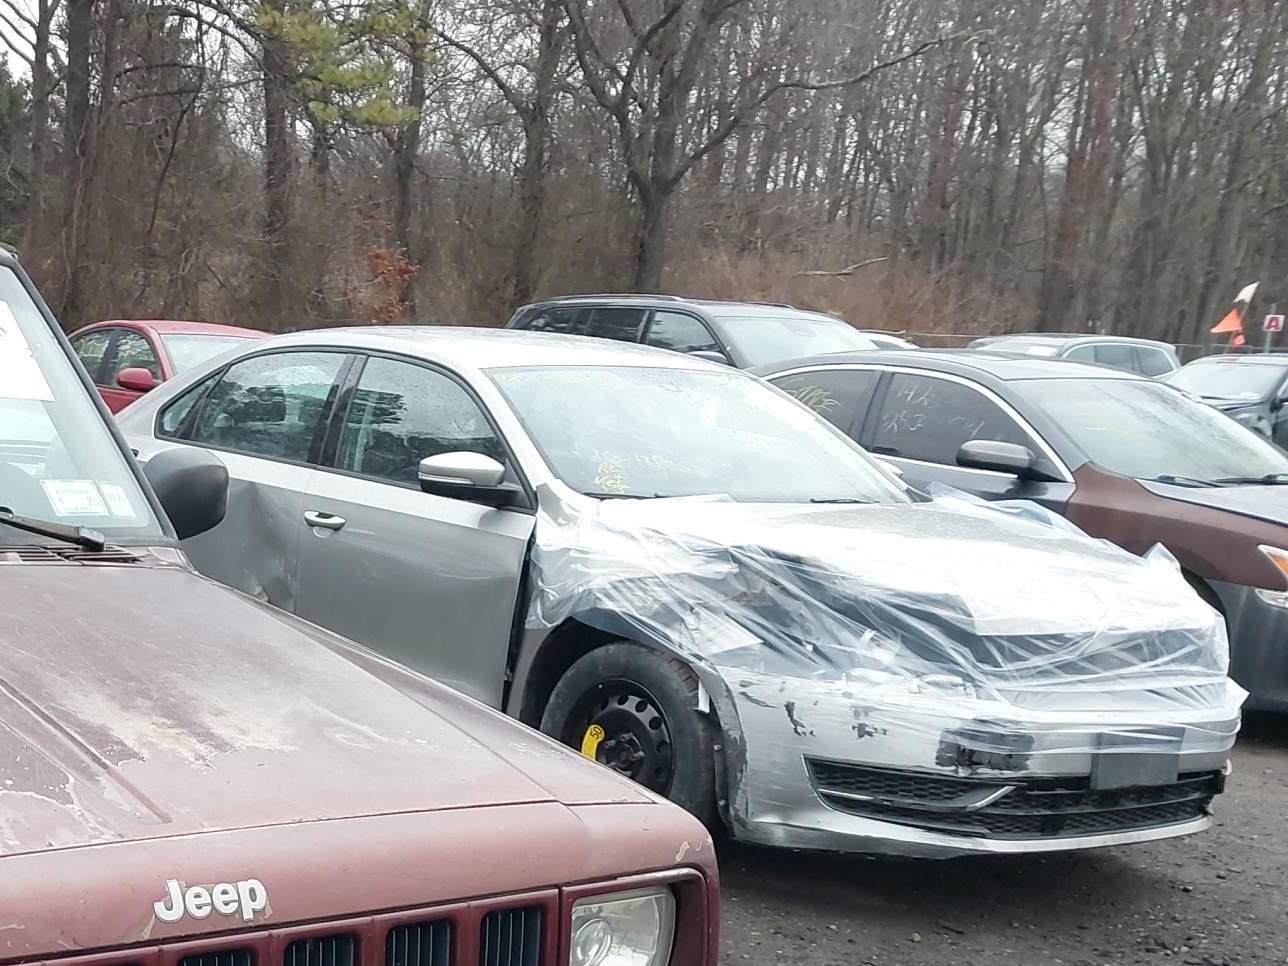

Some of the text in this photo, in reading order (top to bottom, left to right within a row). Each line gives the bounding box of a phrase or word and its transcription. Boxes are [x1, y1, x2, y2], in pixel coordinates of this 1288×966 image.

[1266, 316, 1279, 330] A
[590, 726, 603, 739] 50
[153, 878, 267, 922] Jeep
